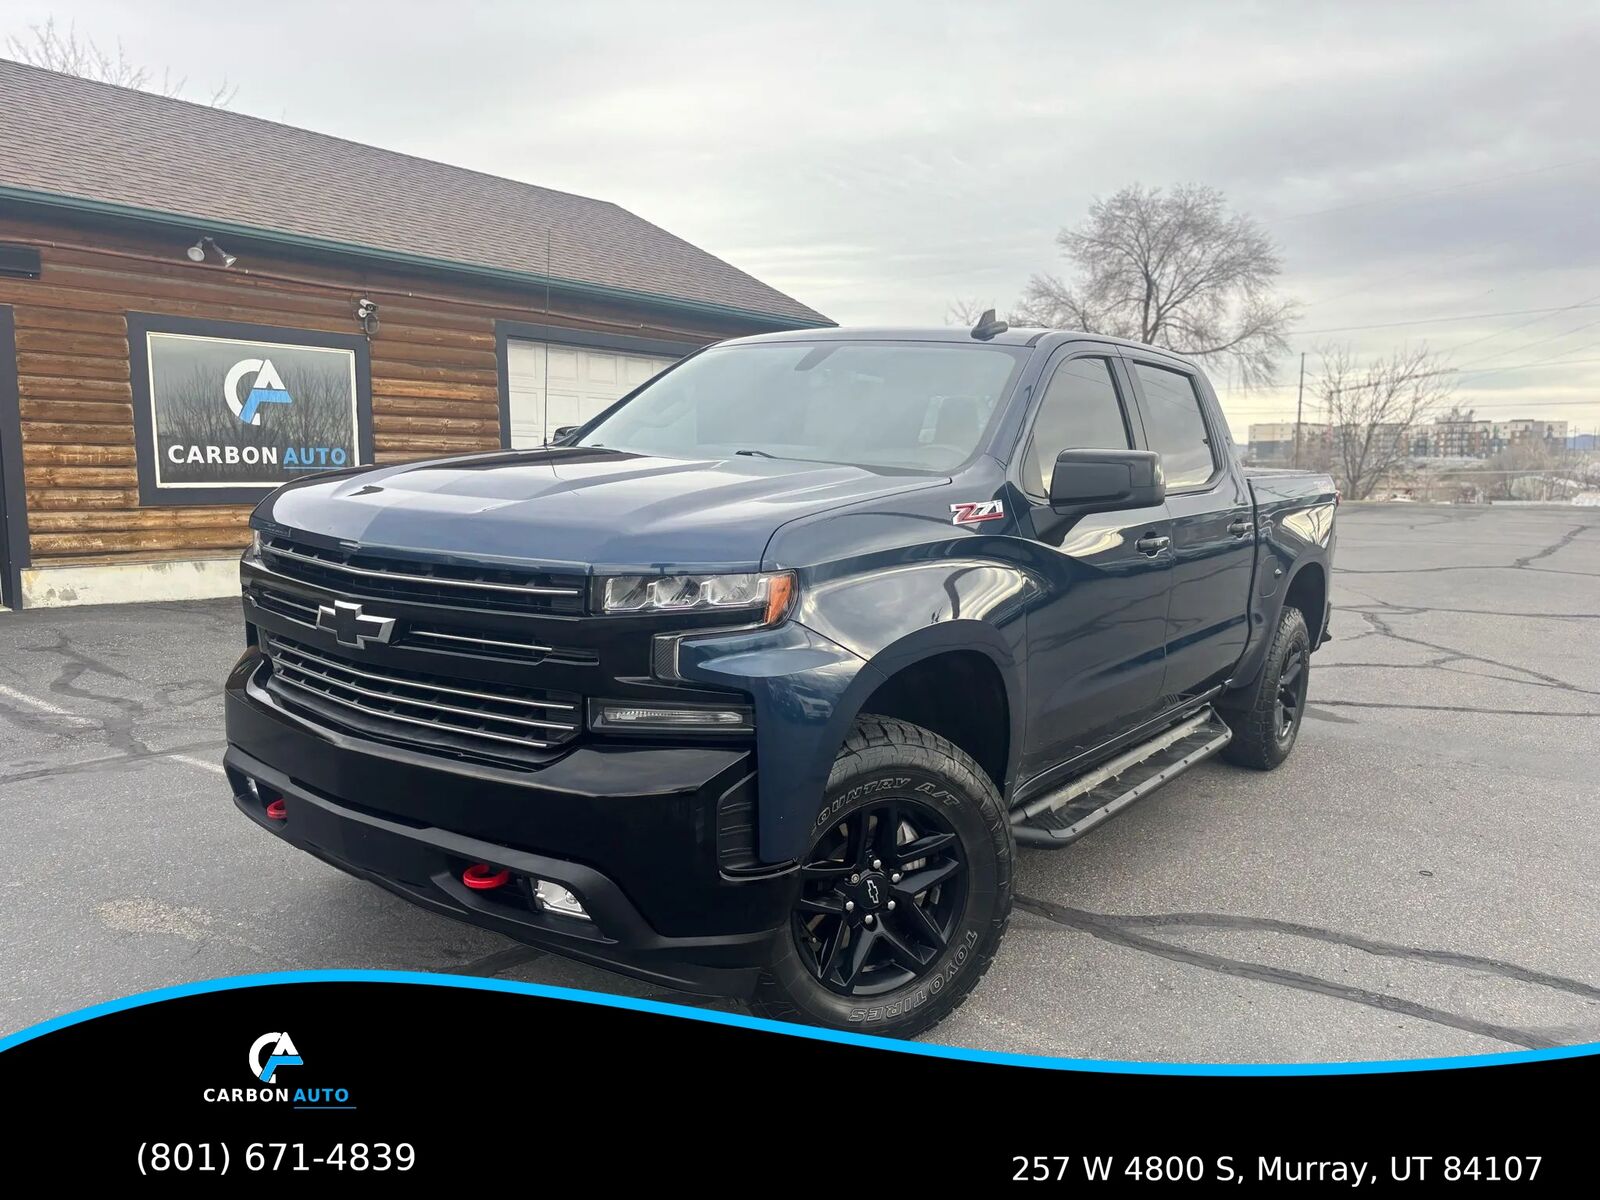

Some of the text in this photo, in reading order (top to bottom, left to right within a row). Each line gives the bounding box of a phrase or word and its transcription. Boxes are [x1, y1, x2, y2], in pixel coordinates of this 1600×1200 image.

[168, 445, 346, 465] CARBON AUTO
[950, 499, 1004, 525] Z71
[811, 778, 911, 832] OUNTRY
[848, 929, 978, 1021] TOYO TIRES
